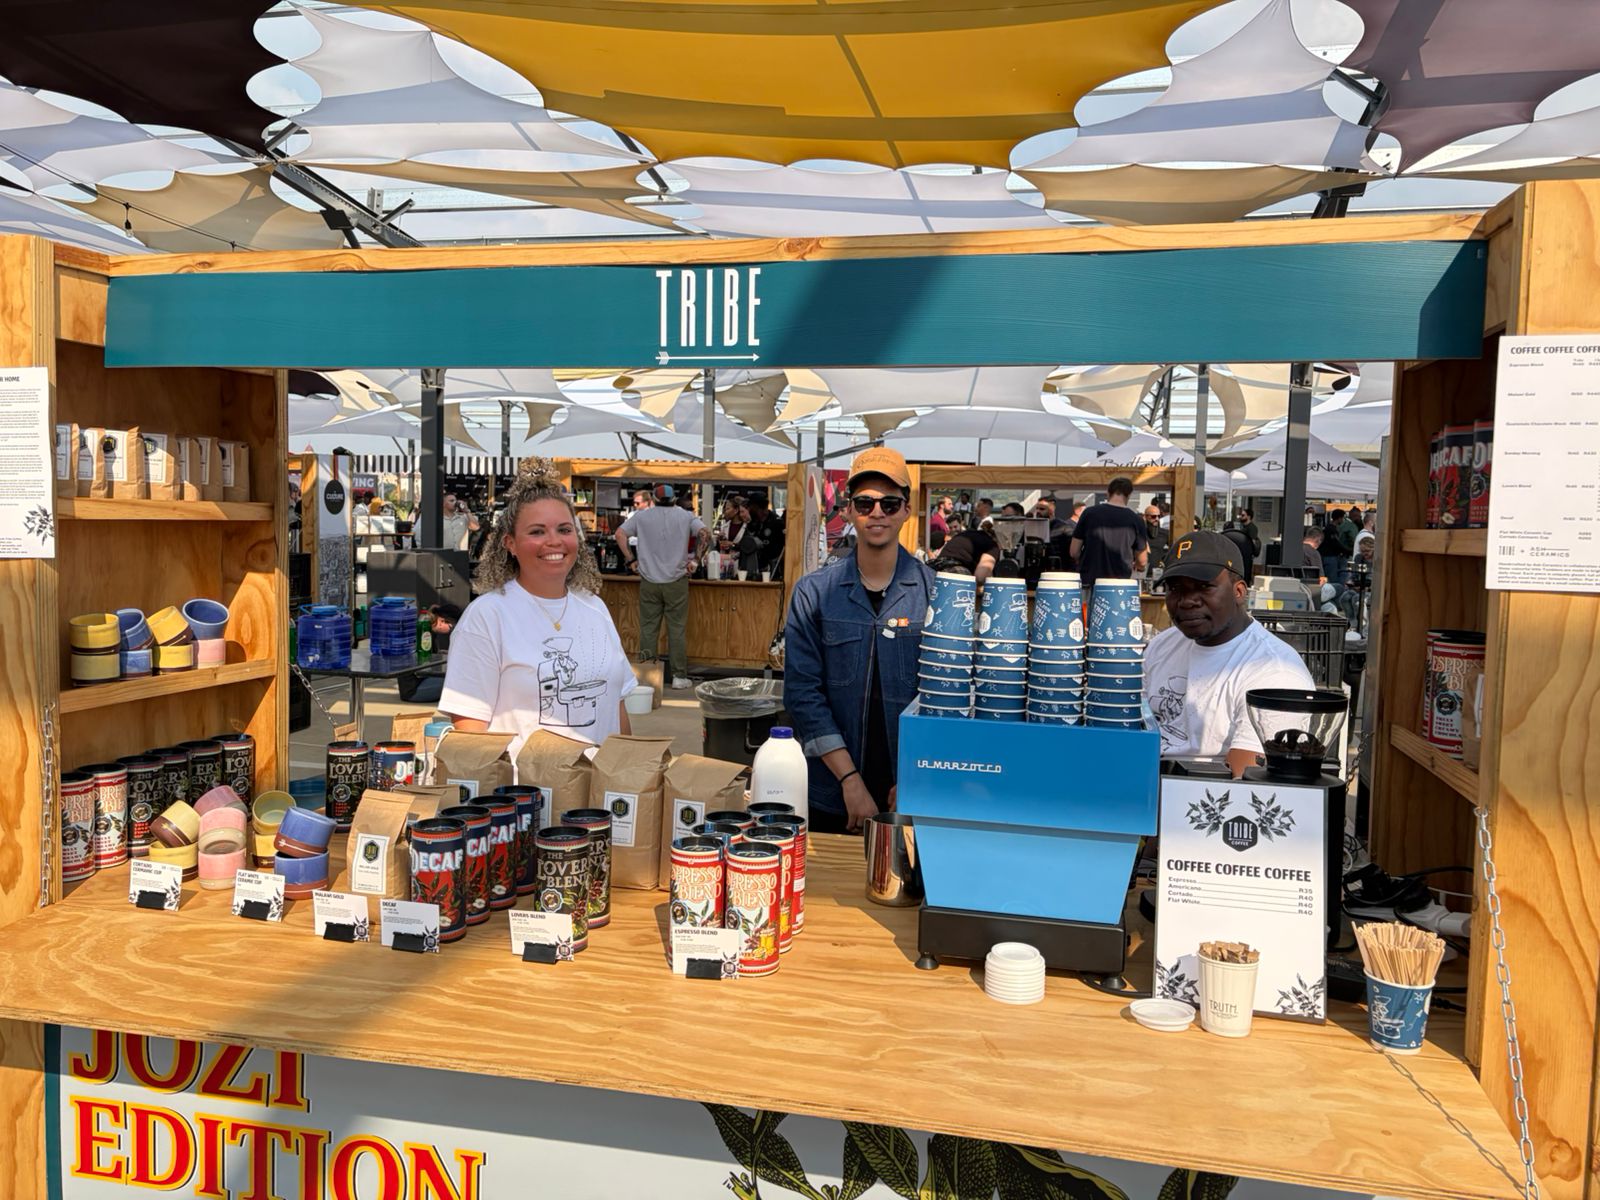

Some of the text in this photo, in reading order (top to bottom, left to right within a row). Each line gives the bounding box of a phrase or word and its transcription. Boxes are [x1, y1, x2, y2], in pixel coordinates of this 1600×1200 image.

[655, 267, 761, 347] TRIBE
[1510, 346, 1541, 354] COFFEE
[1543, 346, 1574, 354] COFFEE
[1176, 540, 1193, 559] P
[409, 842, 464, 874] DECAF
[1166, 859, 1312, 882] COFFEE COFFEE COFFEE
[1168, 876, 1197, 884] Espresso
[1168, 883, 1202, 891] Americano
[69, 1095, 486, 1200] EDITION
